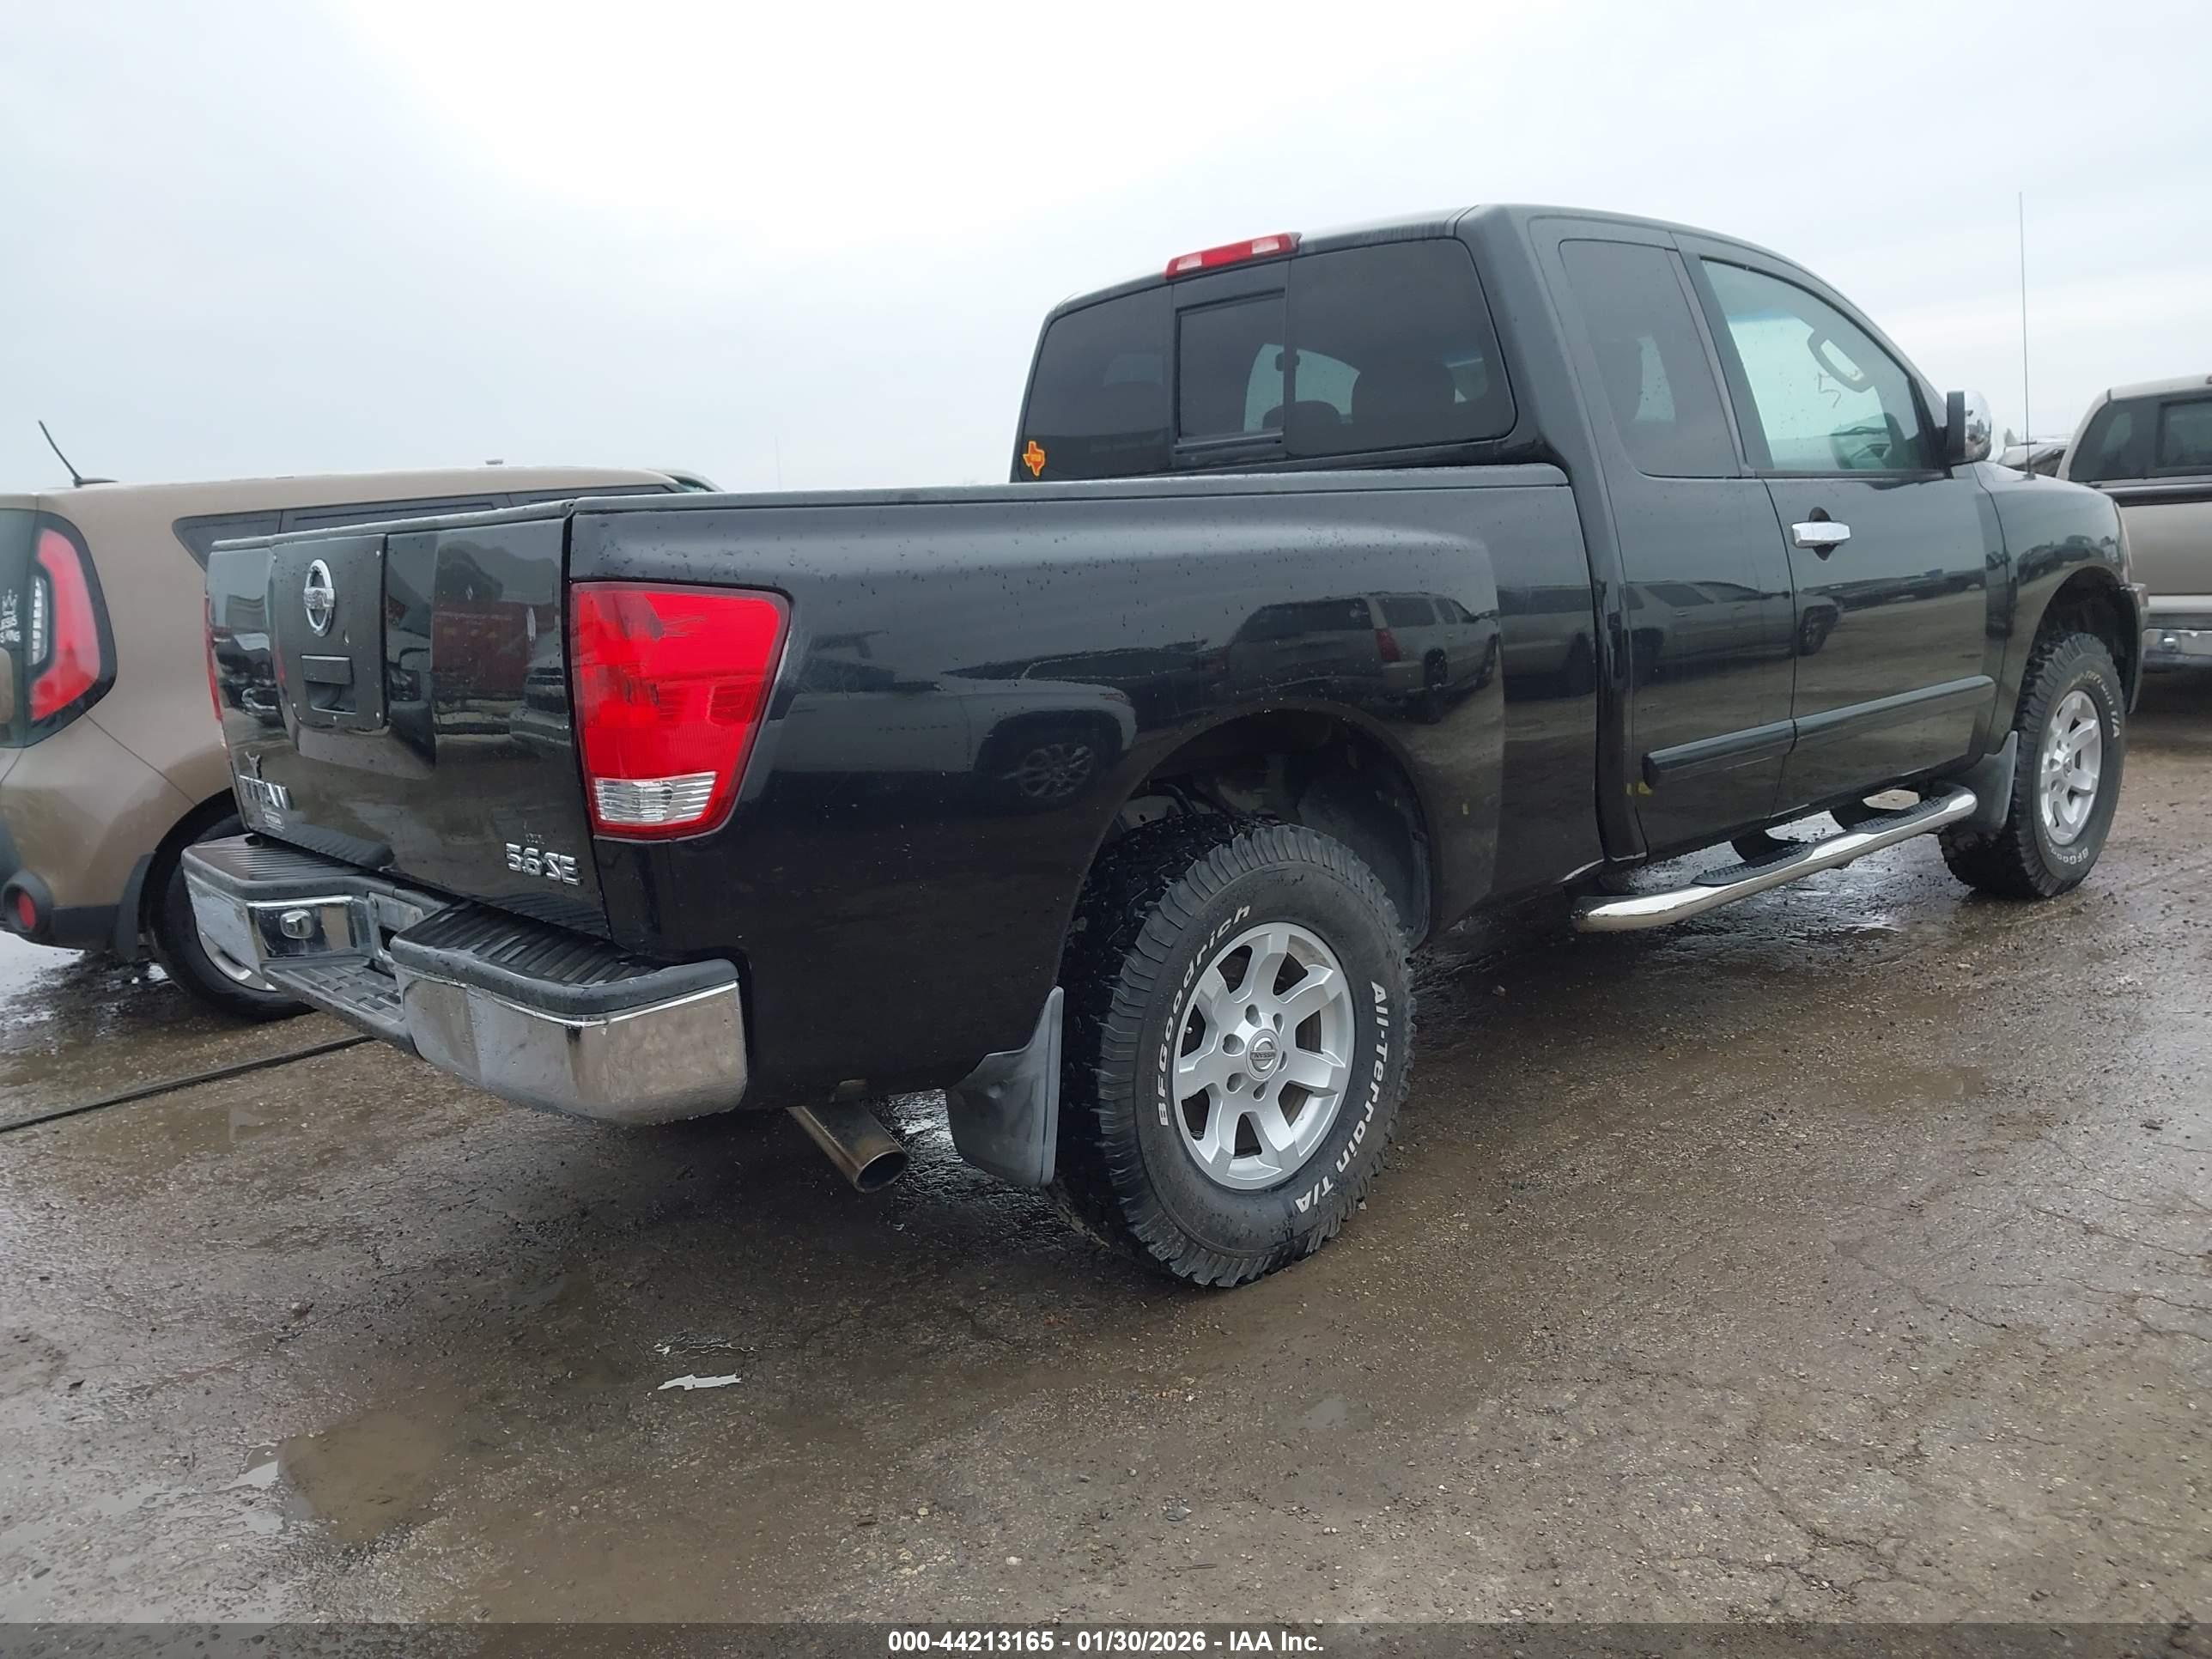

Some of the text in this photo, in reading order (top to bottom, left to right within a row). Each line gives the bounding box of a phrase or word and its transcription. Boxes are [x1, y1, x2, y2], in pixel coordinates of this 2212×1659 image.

[1158, 904, 1251, 1126] BFGoodrich
[1295, 981, 1390, 1214] All-Terrain T/A
